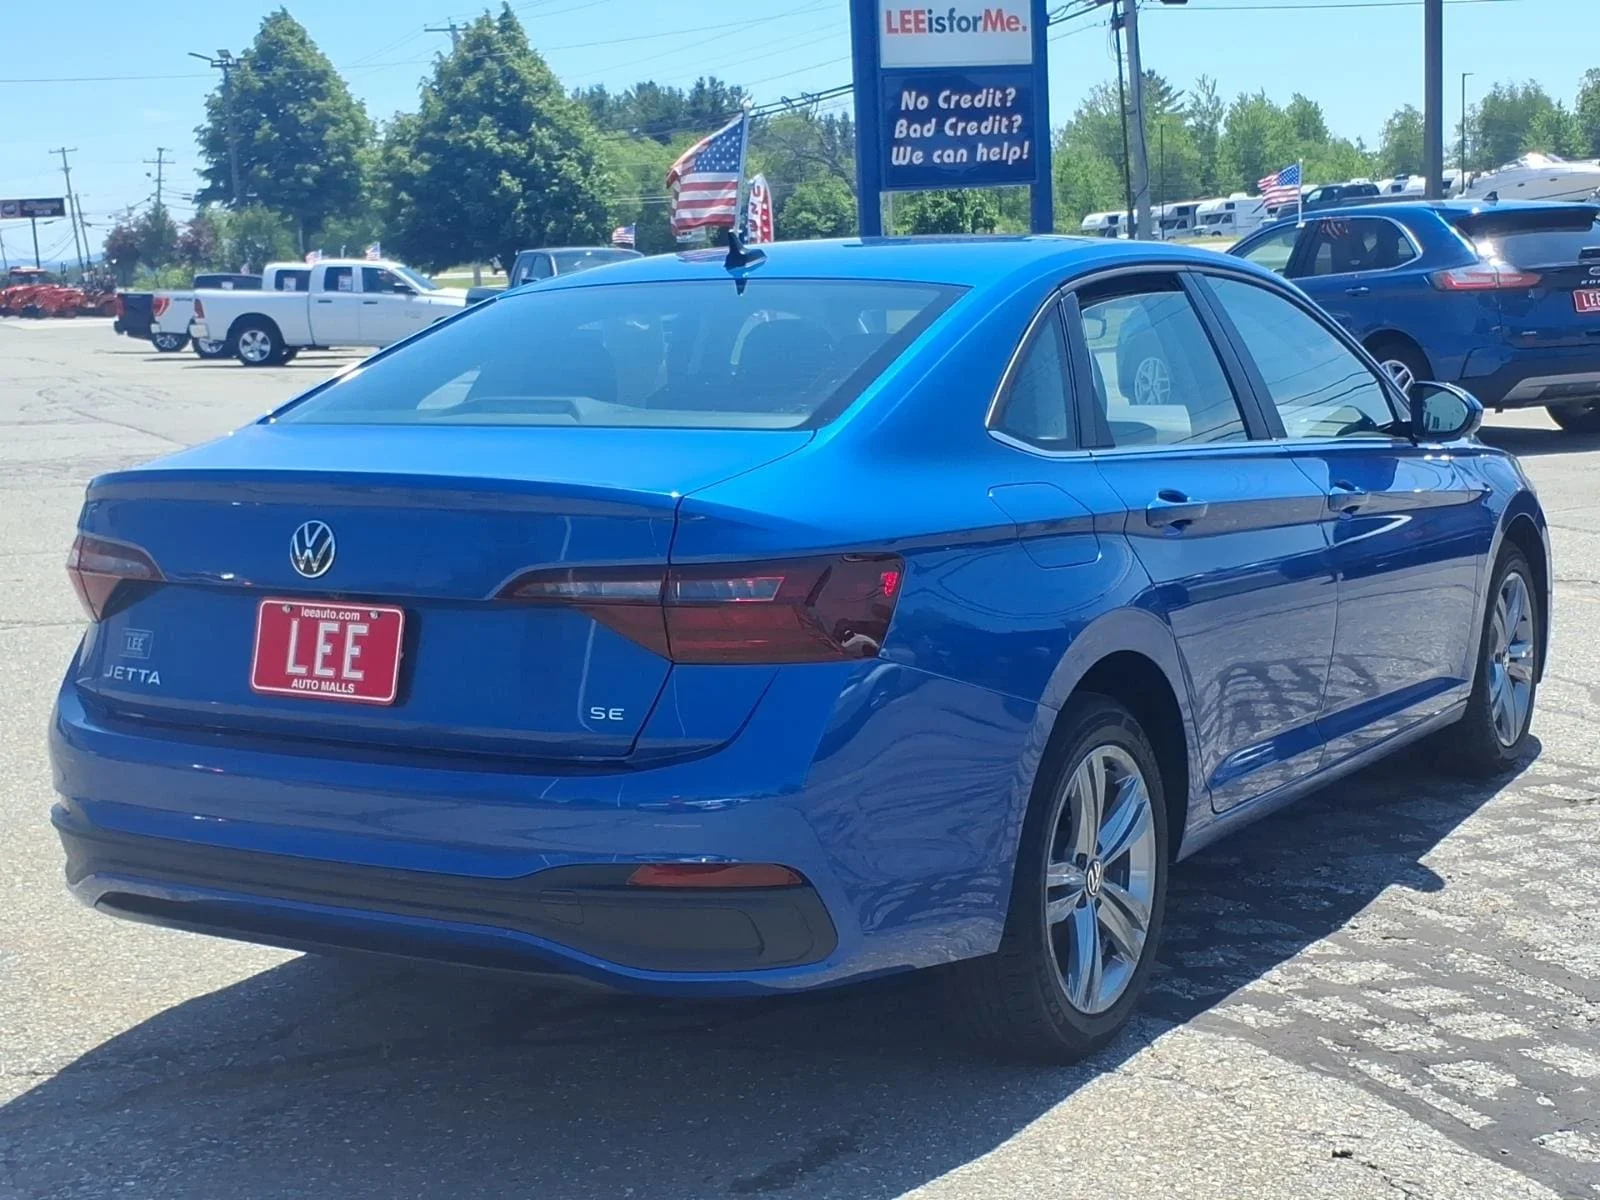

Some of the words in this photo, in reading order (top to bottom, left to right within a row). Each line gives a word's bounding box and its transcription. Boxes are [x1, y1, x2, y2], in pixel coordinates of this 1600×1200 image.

[886, 8, 1027, 34] LEEisforMe.
[901, 91, 929, 111] No
[938, 88, 1016, 109] Credit?
[894, 118, 936, 139] Bad
[944, 115, 1022, 136] Credit?
[891, 147, 924, 166] We
[932, 149, 968, 164] can
[976, 141, 1030, 165] help!
[301, 606, 360, 621] leeauto.com
[286, 618, 369, 681] LEE
[103, 664, 162, 685] JETTA
[291, 678, 319, 691] AUTO
[320, 681, 355, 694] MALLS
[590, 706, 625, 721] SE
